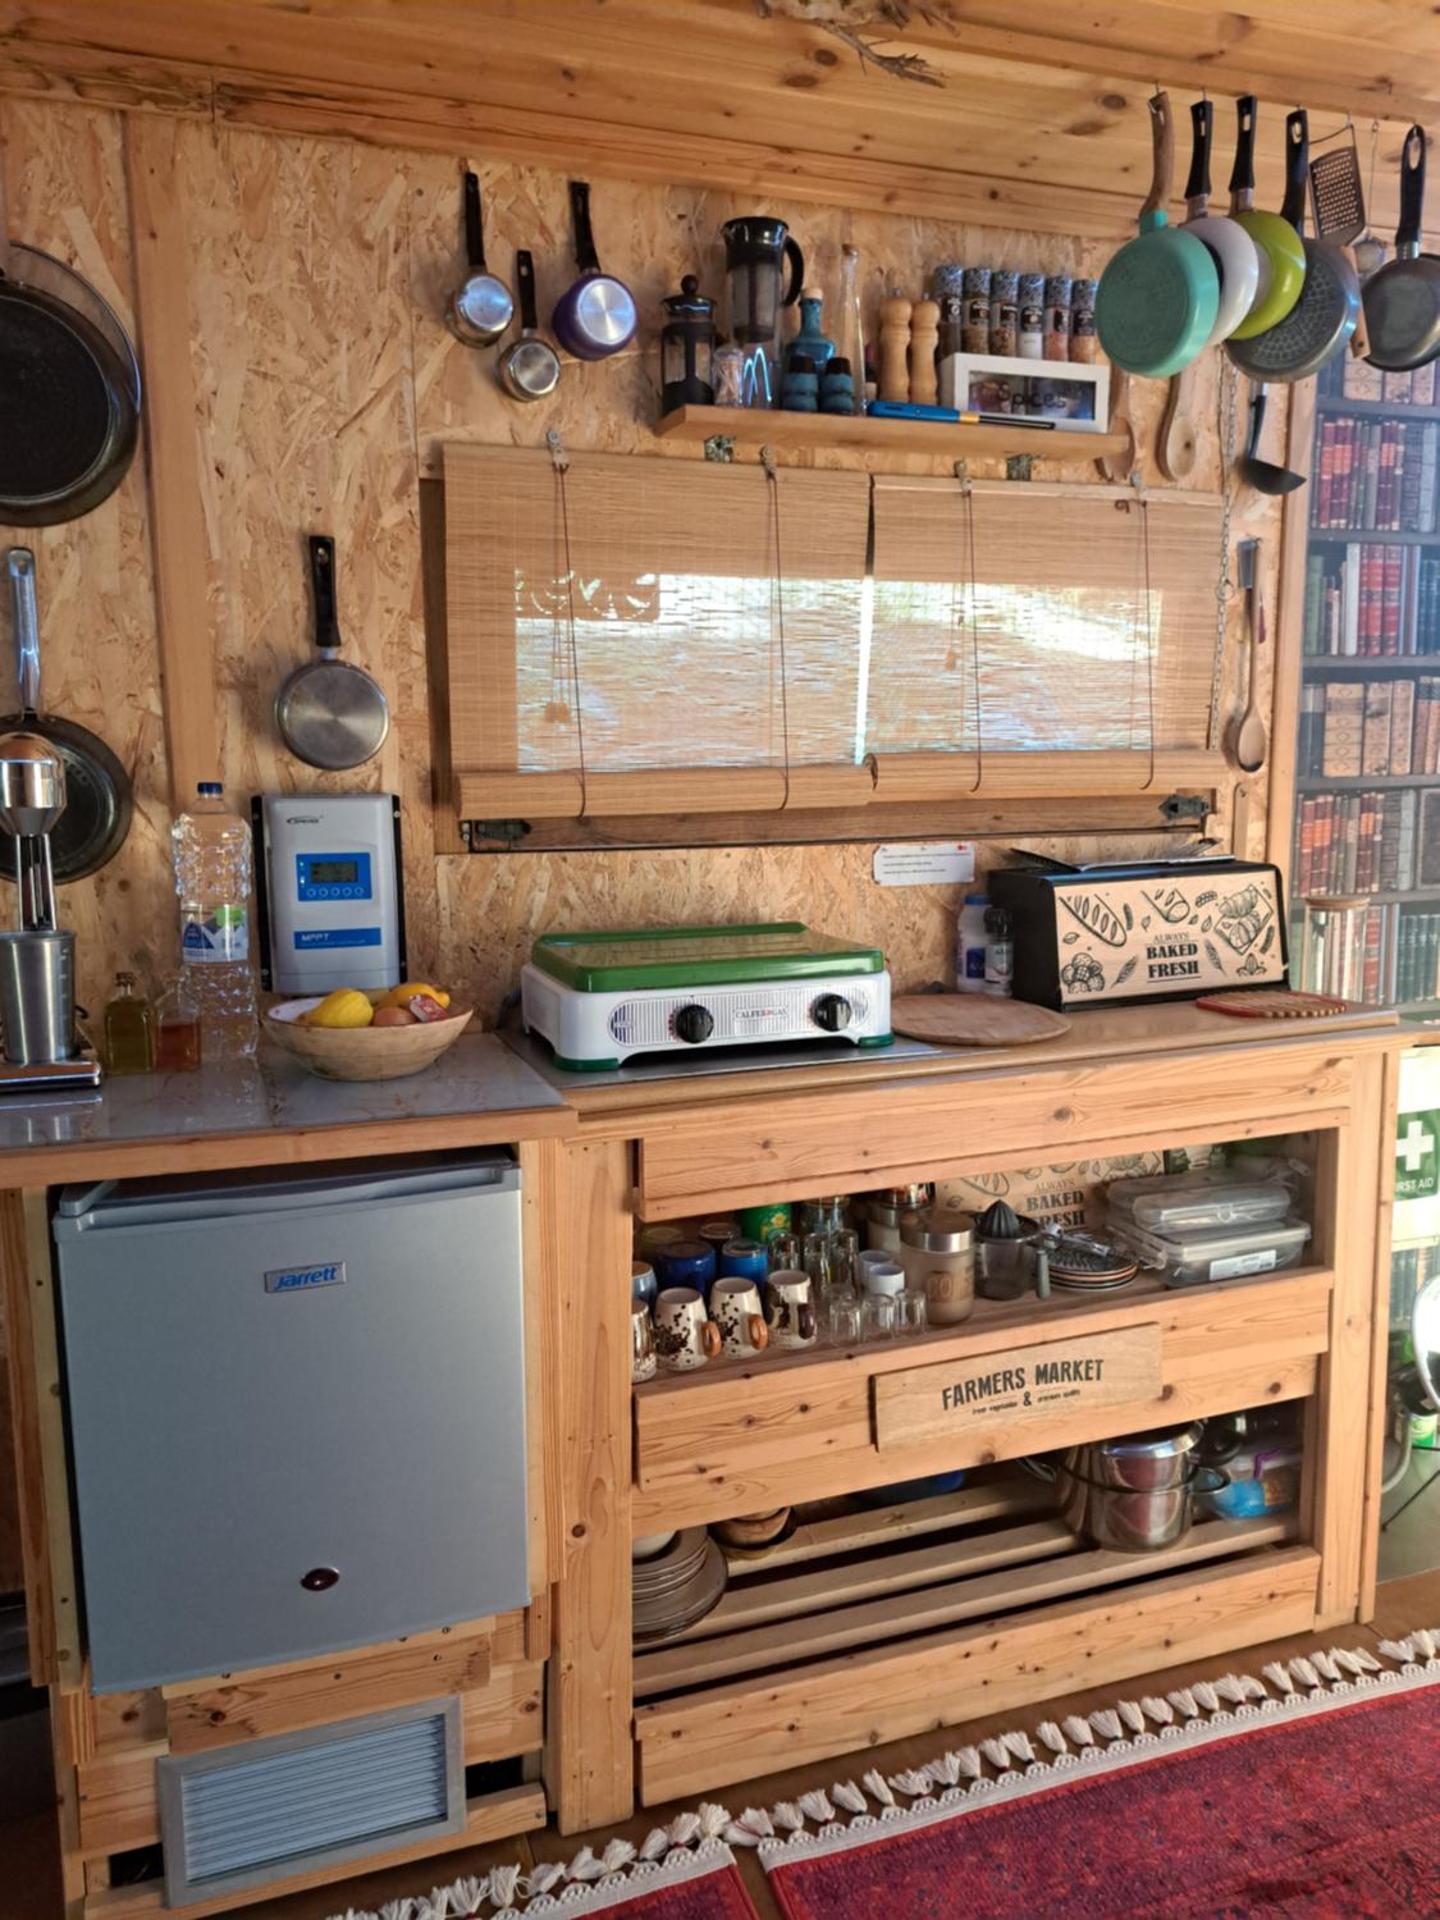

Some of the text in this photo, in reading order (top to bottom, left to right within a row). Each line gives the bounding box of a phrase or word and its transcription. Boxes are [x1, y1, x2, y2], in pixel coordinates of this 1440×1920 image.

[301, 933, 329, 942] MPPT
[1152, 931, 1191, 945] ALWAYS
[1146, 942, 1199, 960] BAKED
[1148, 960, 1199, 978] FRESH
[1418, 1177, 1434, 1190] AID
[1026, 1190, 1085, 1212] BAKED
[1039, 1210, 1085, 1231] RESH
[941, 1366, 1026, 1411] FARMERS
[1034, 1358, 1105, 1387] MARKET
[1023, 1390, 1033, 1408] &
